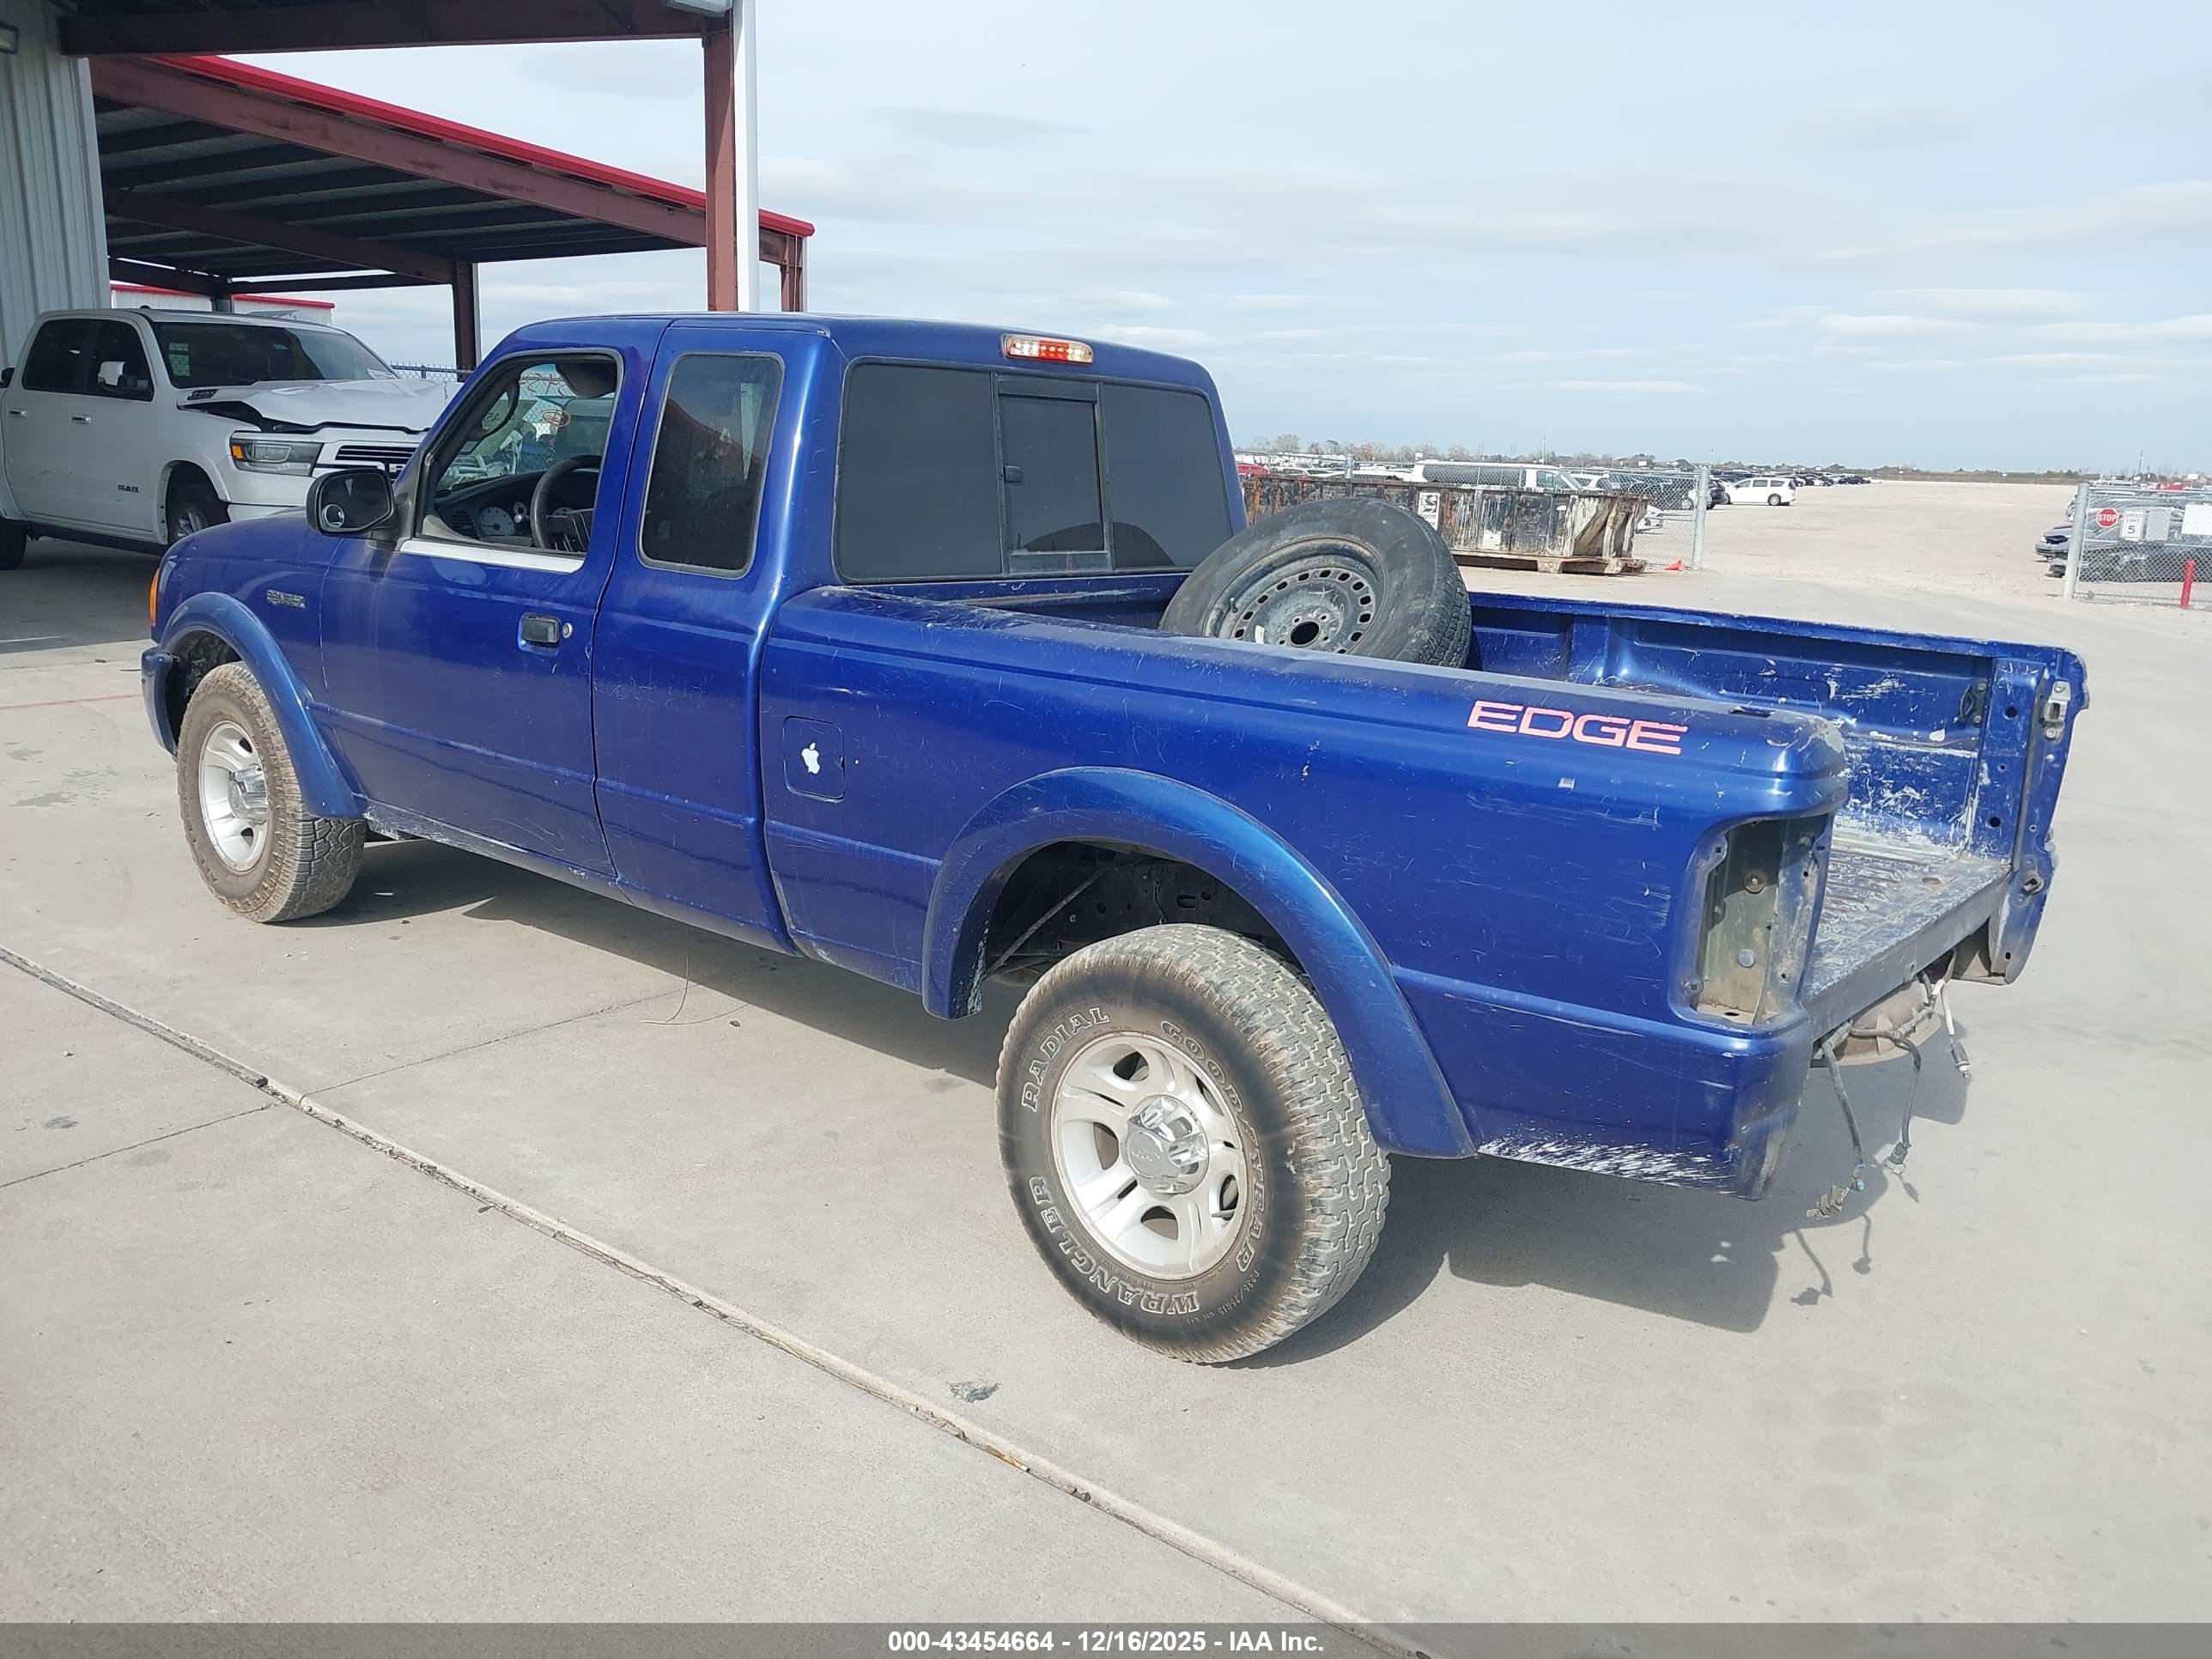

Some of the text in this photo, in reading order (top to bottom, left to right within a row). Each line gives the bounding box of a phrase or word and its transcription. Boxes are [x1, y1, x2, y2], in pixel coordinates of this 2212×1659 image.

[2098, 514, 2118, 522] STOP
[2128, 525, 2136, 534] 5
[1468, 700, 1689, 757] EDGE
[1020, 1006, 1111, 1113] RADIAL
[1028, 1176, 1201, 1316] WRANGLER
